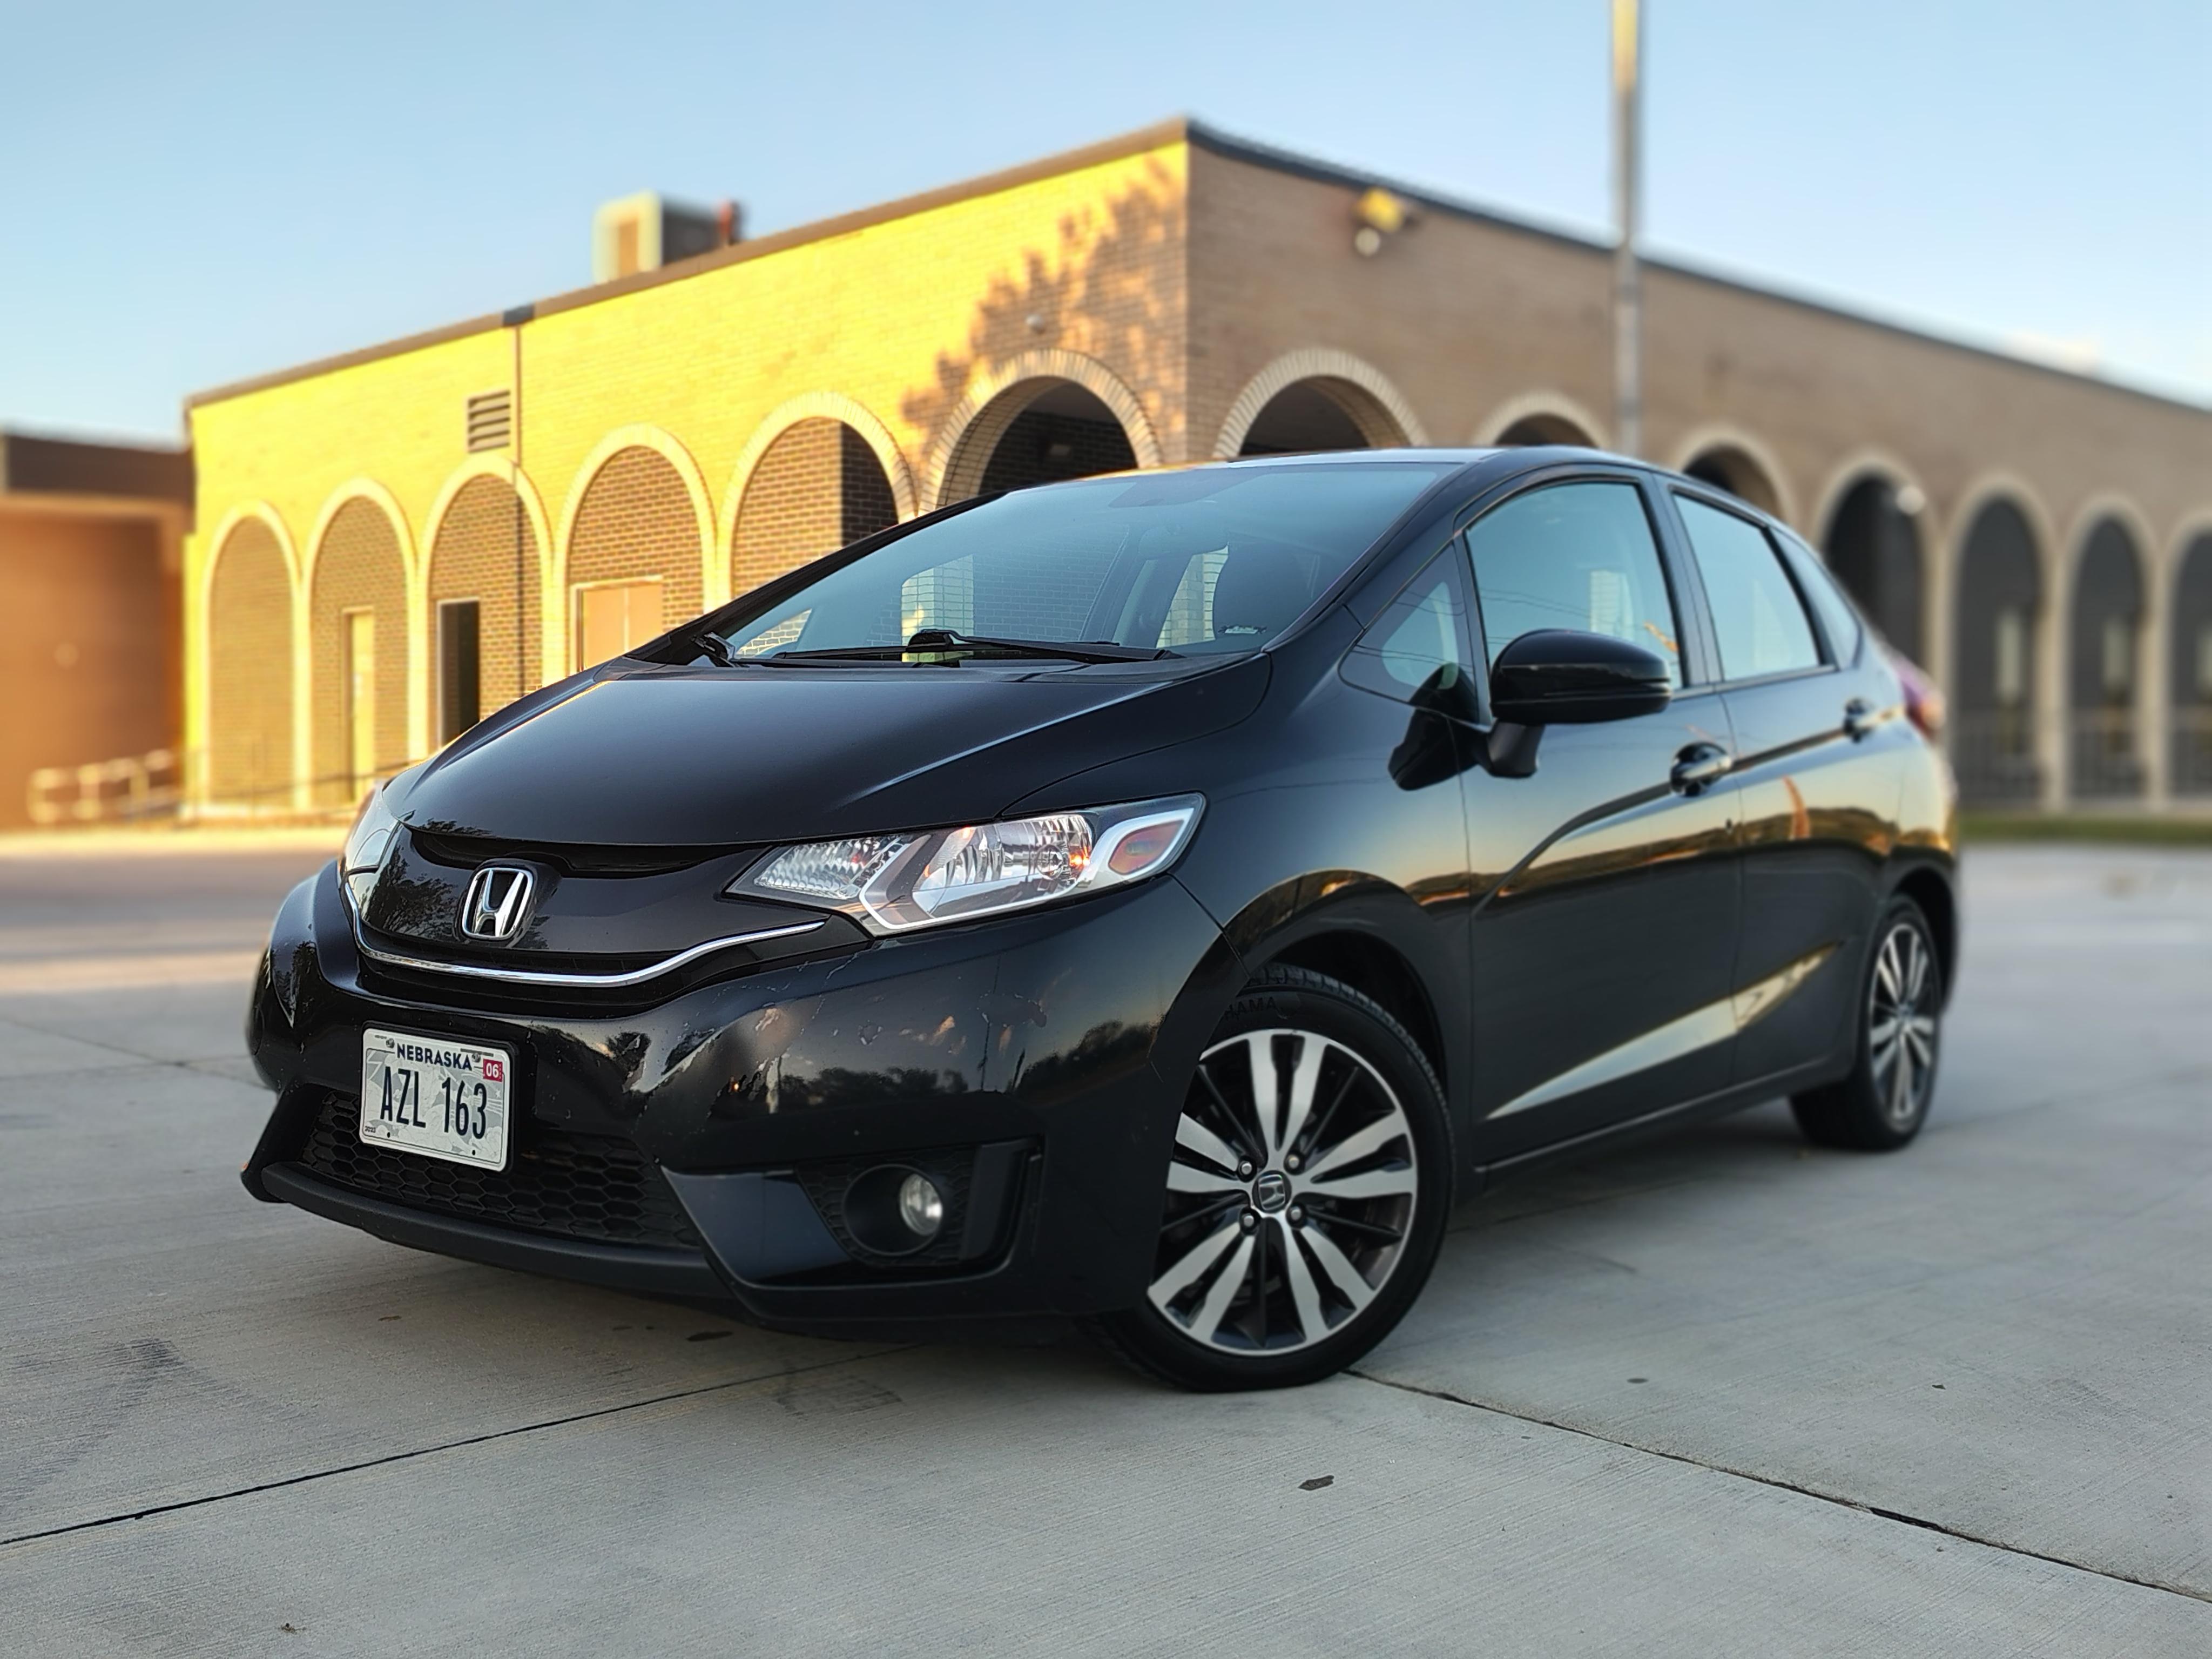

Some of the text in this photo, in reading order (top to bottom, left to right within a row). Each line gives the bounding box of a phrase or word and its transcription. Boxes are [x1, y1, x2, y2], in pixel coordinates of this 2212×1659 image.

[397, 1043, 473, 1071] NEBRASKA
[486, 1063, 499, 1078] 06
[380, 1066, 487, 1139] AZL 163
